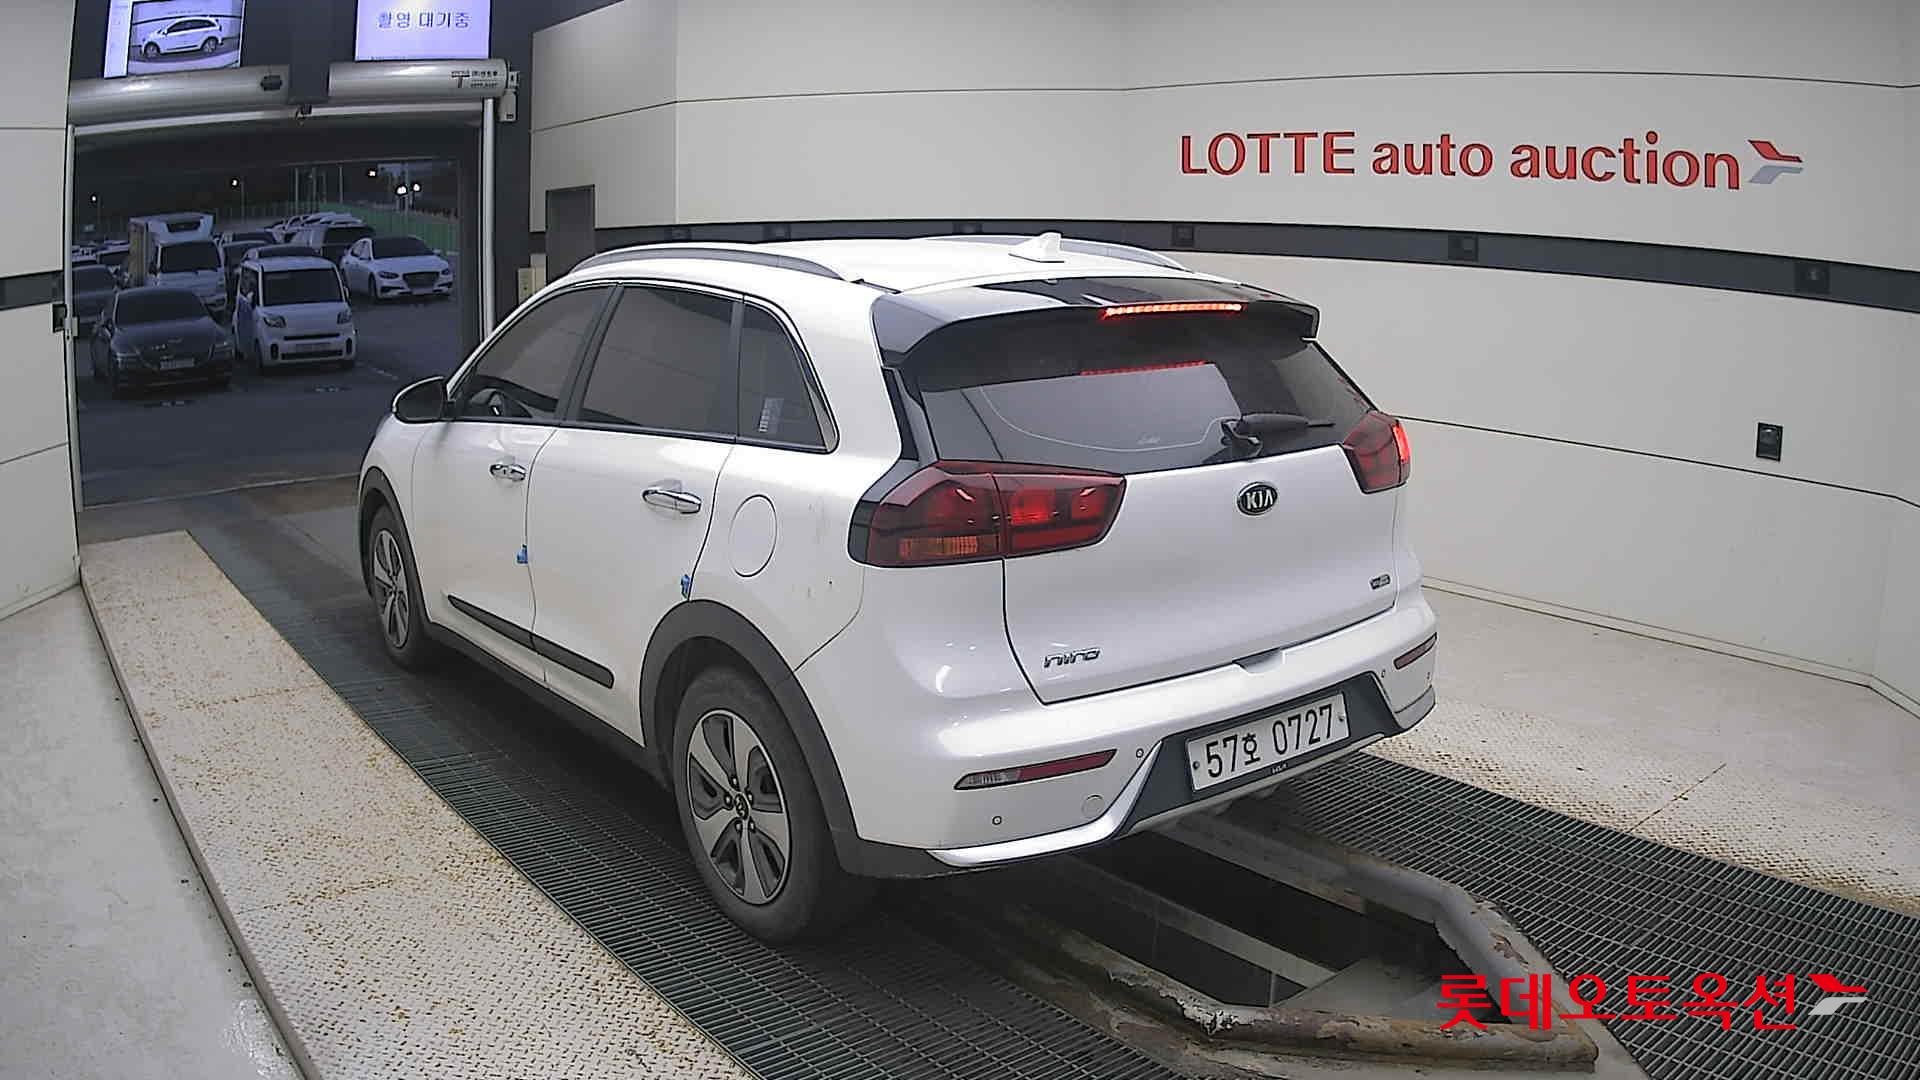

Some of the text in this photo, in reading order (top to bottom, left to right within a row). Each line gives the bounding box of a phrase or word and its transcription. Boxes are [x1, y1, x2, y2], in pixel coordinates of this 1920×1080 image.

[1181, 130, 1740, 190] LOTTE auto auction
[1245, 490, 1273, 508] KIA
[1206, 704, 1334, 778] 57호 0727
